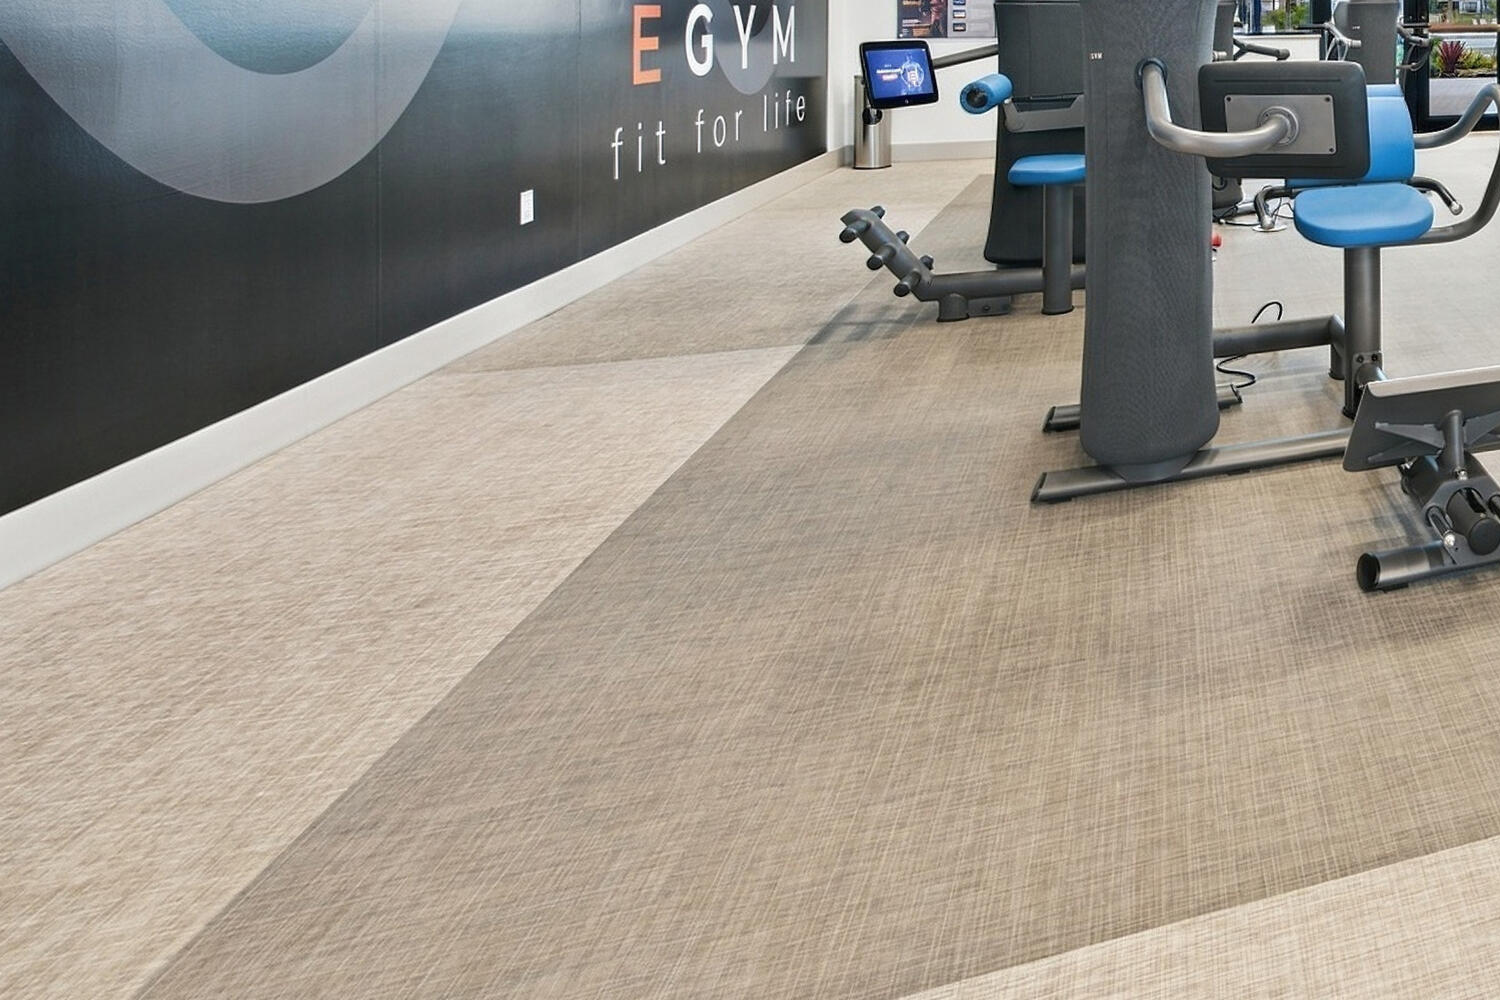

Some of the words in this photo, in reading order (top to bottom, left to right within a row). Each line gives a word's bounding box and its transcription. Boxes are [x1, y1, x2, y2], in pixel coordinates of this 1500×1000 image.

[632, 3, 796, 86] EGYM
[611, 120, 666, 180] fit
[695, 108, 743, 154] for
[763, 89, 806, 133] life
